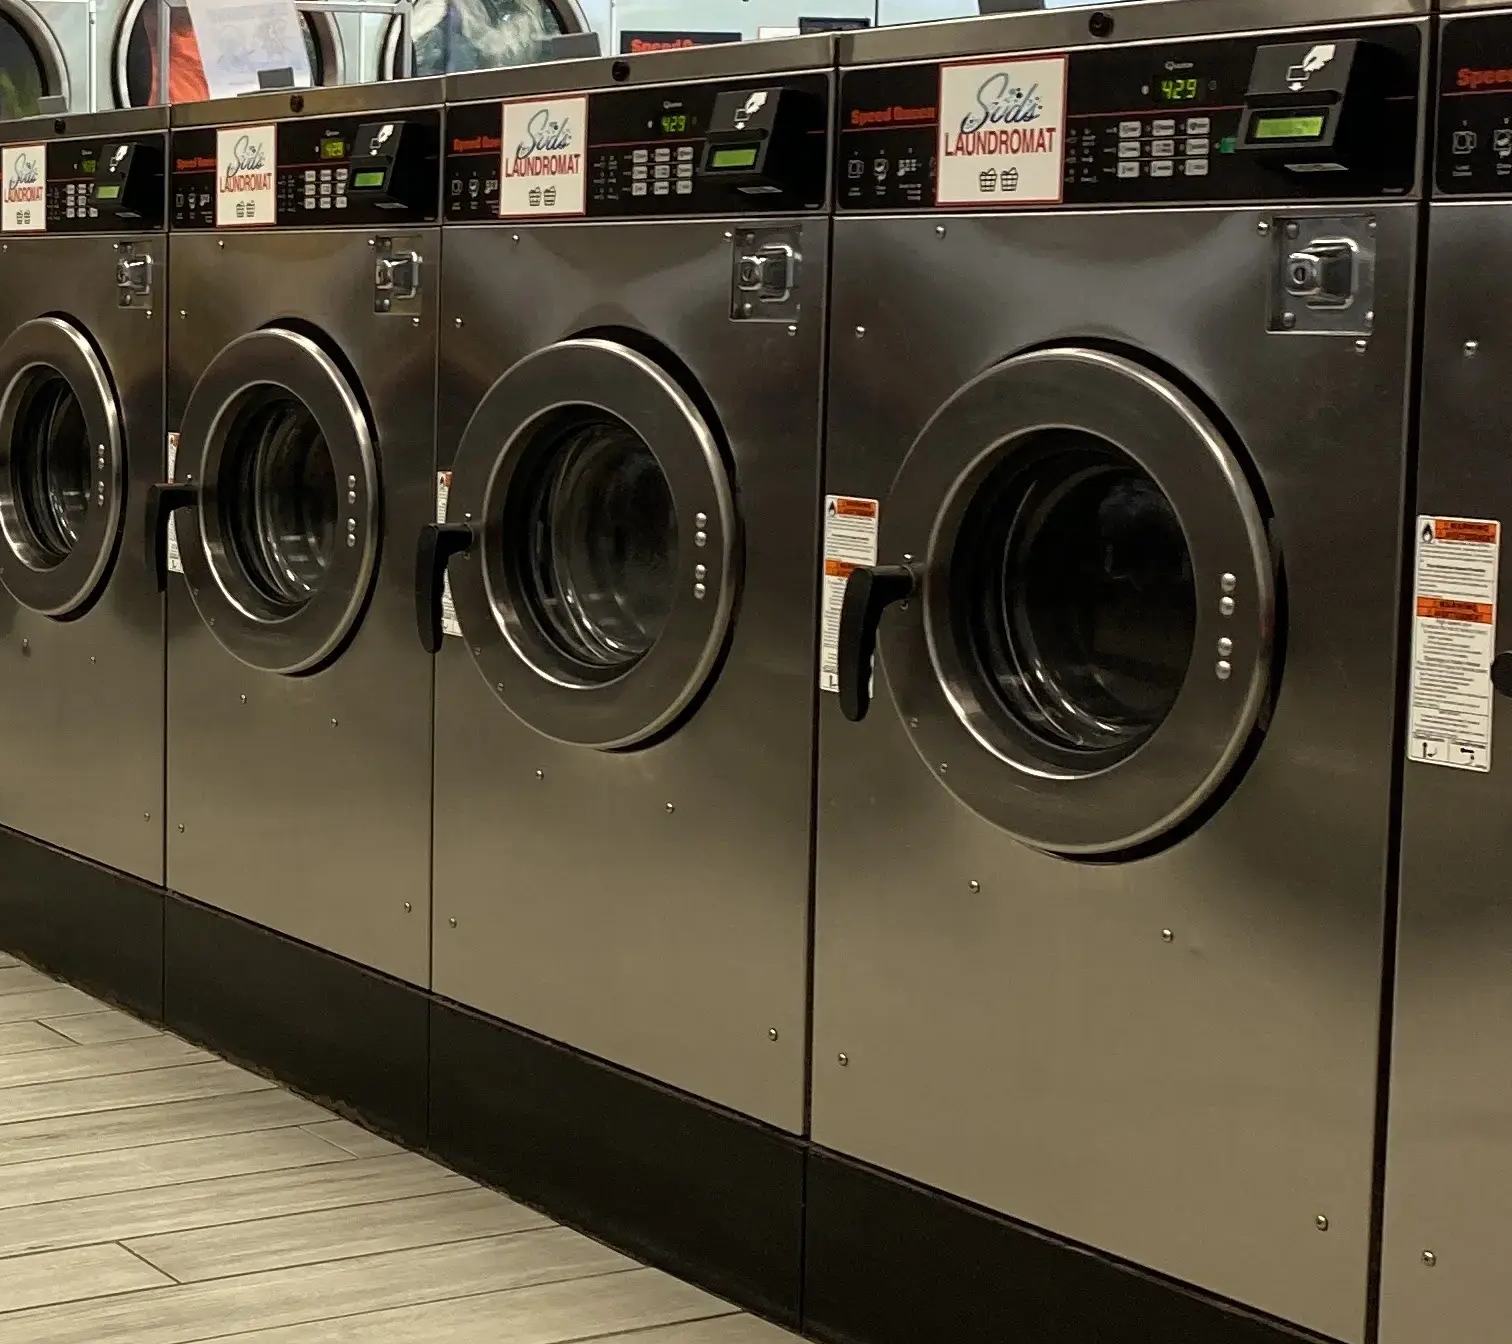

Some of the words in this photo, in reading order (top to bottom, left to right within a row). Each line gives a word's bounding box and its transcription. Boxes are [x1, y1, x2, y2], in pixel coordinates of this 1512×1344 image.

[851, 106, 893, 125] Speed
[961, 72, 1043, 134] Suds
[516, 108, 571, 159] Suds
[945, 127, 1056, 156] LAUNDROMAT
[505, 154, 581, 177] LAUNDROMAT
